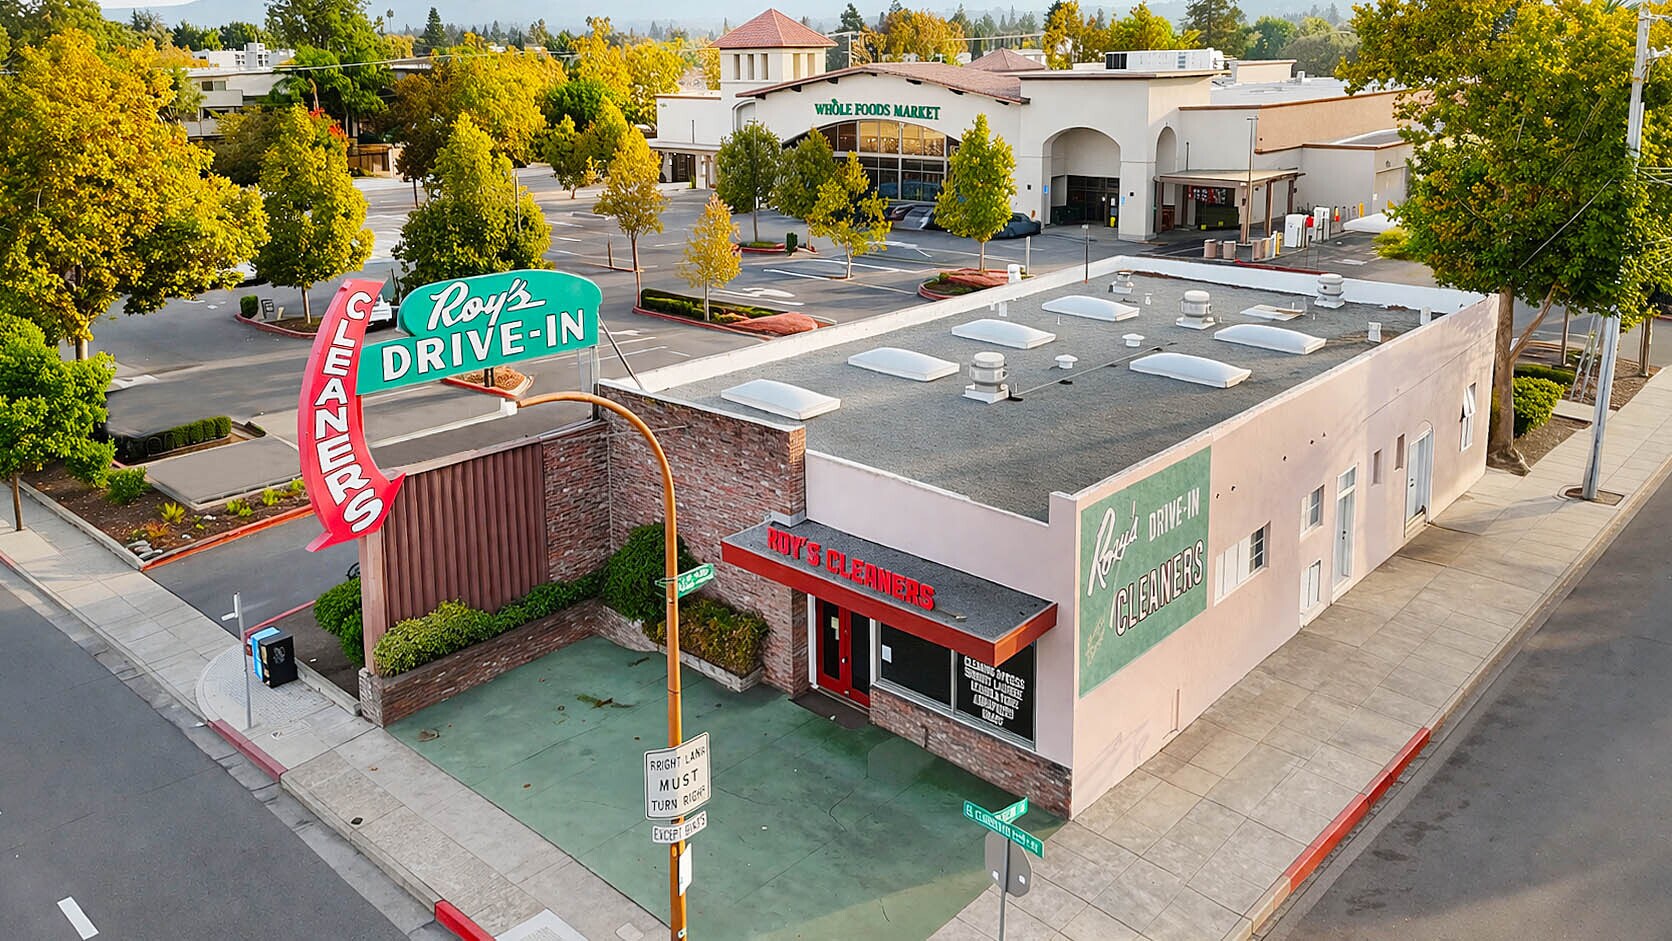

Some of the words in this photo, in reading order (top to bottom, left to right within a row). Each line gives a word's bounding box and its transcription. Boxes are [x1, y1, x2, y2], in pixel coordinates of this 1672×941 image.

[815, 98, 852, 115] WHOLE
[855, 103, 890, 116] FOODS
[894, 104, 940, 120] MARKET
[427, 278, 546, 331] Roy's
[381, 309, 585, 383] DRIVE-IN
[314, 291, 383, 534] CLEANERS
[1149, 487, 1201, 542] DRIVE-IN
[767, 526, 821, 567] ROY'S
[826, 548, 936, 611] CLEANERS
[1114, 539, 1204, 637] CLEANERS
[651, 799, 678, 811] TURN
[660, 768, 698, 792] MUST
